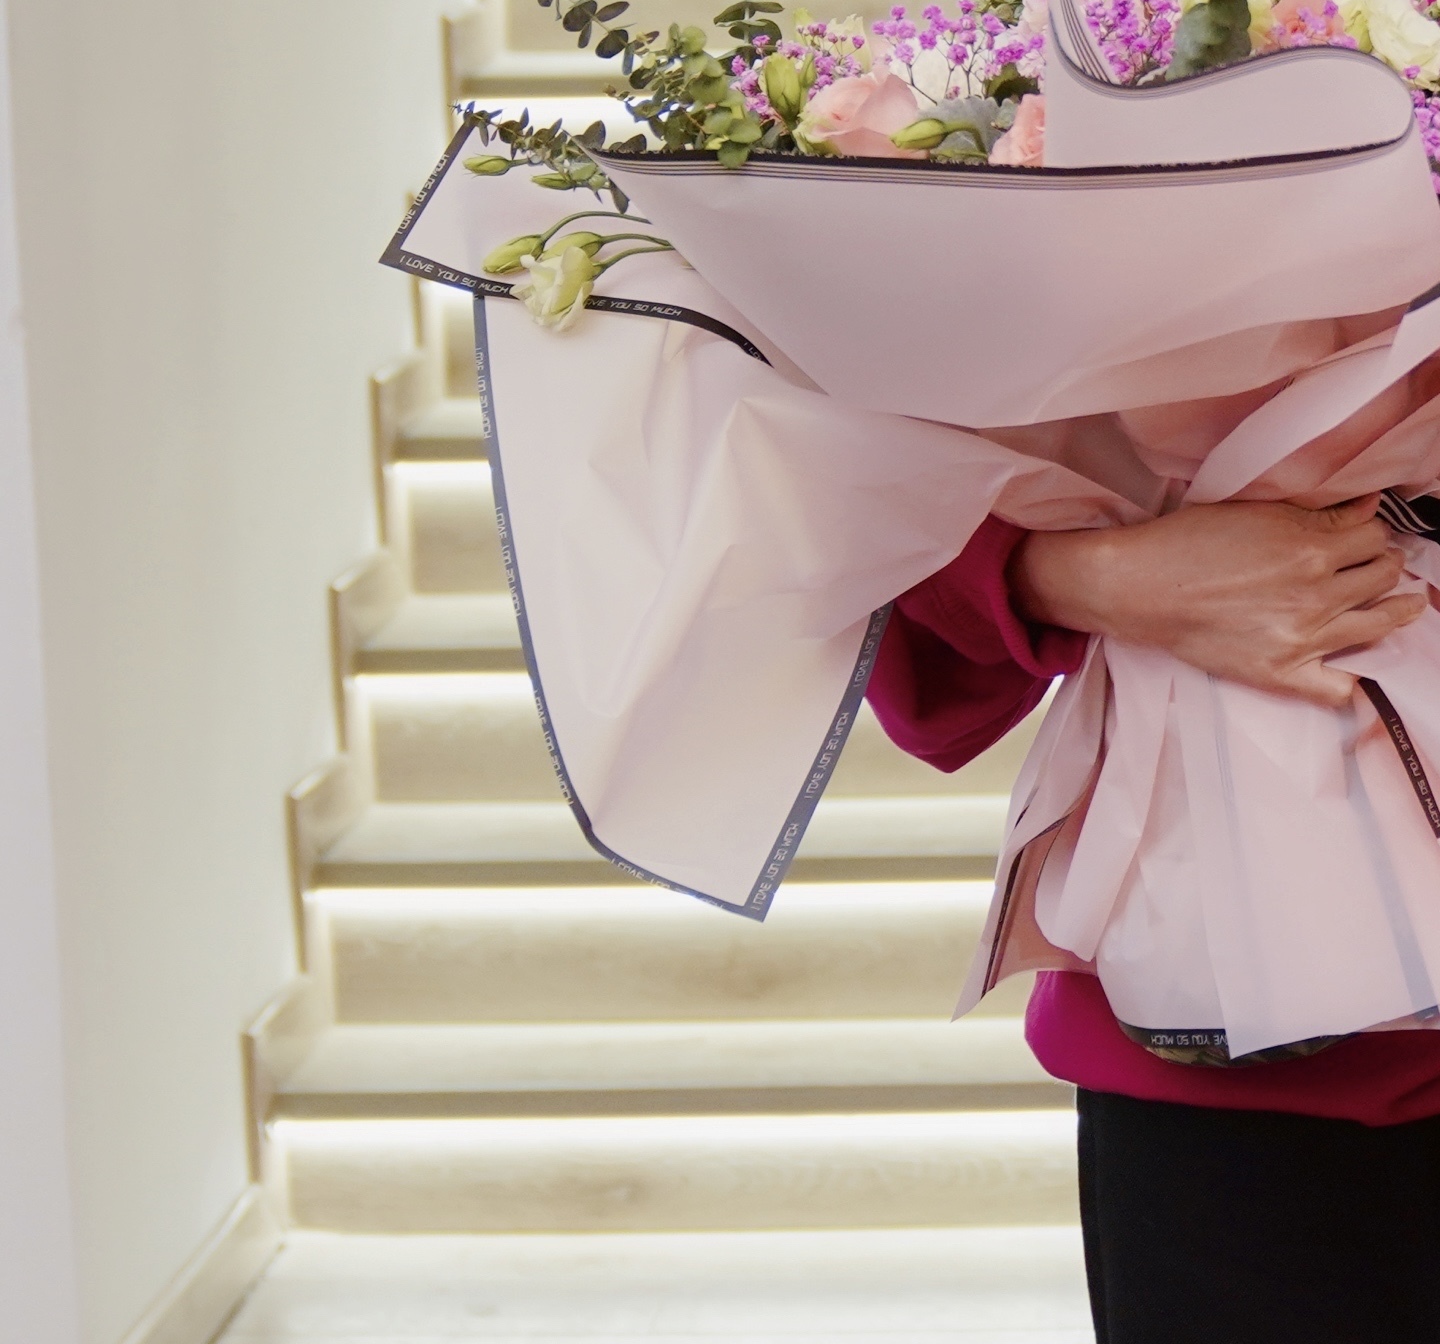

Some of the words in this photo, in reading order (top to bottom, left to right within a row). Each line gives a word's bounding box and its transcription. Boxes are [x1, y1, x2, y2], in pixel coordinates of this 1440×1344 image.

[400, 255, 406, 264] I
[406, 257, 434, 274] LOVE
[438, 268, 460, 282] YOU
[460, 276, 476, 288] SO
[479, 282, 509, 294] MUCH
[610, 300, 632, 311] YOU
[634, 302, 651, 312] SO
[652, 305, 682, 317] MUCH
[1392, 724, 1410, 751] LOVE
[1406, 754, 1422, 777] YOU
[1417, 780, 1428, 796] SO
[1151, 1035, 1174, 1046] MUCH
[1192, 1035, 1210, 1046] YOU
